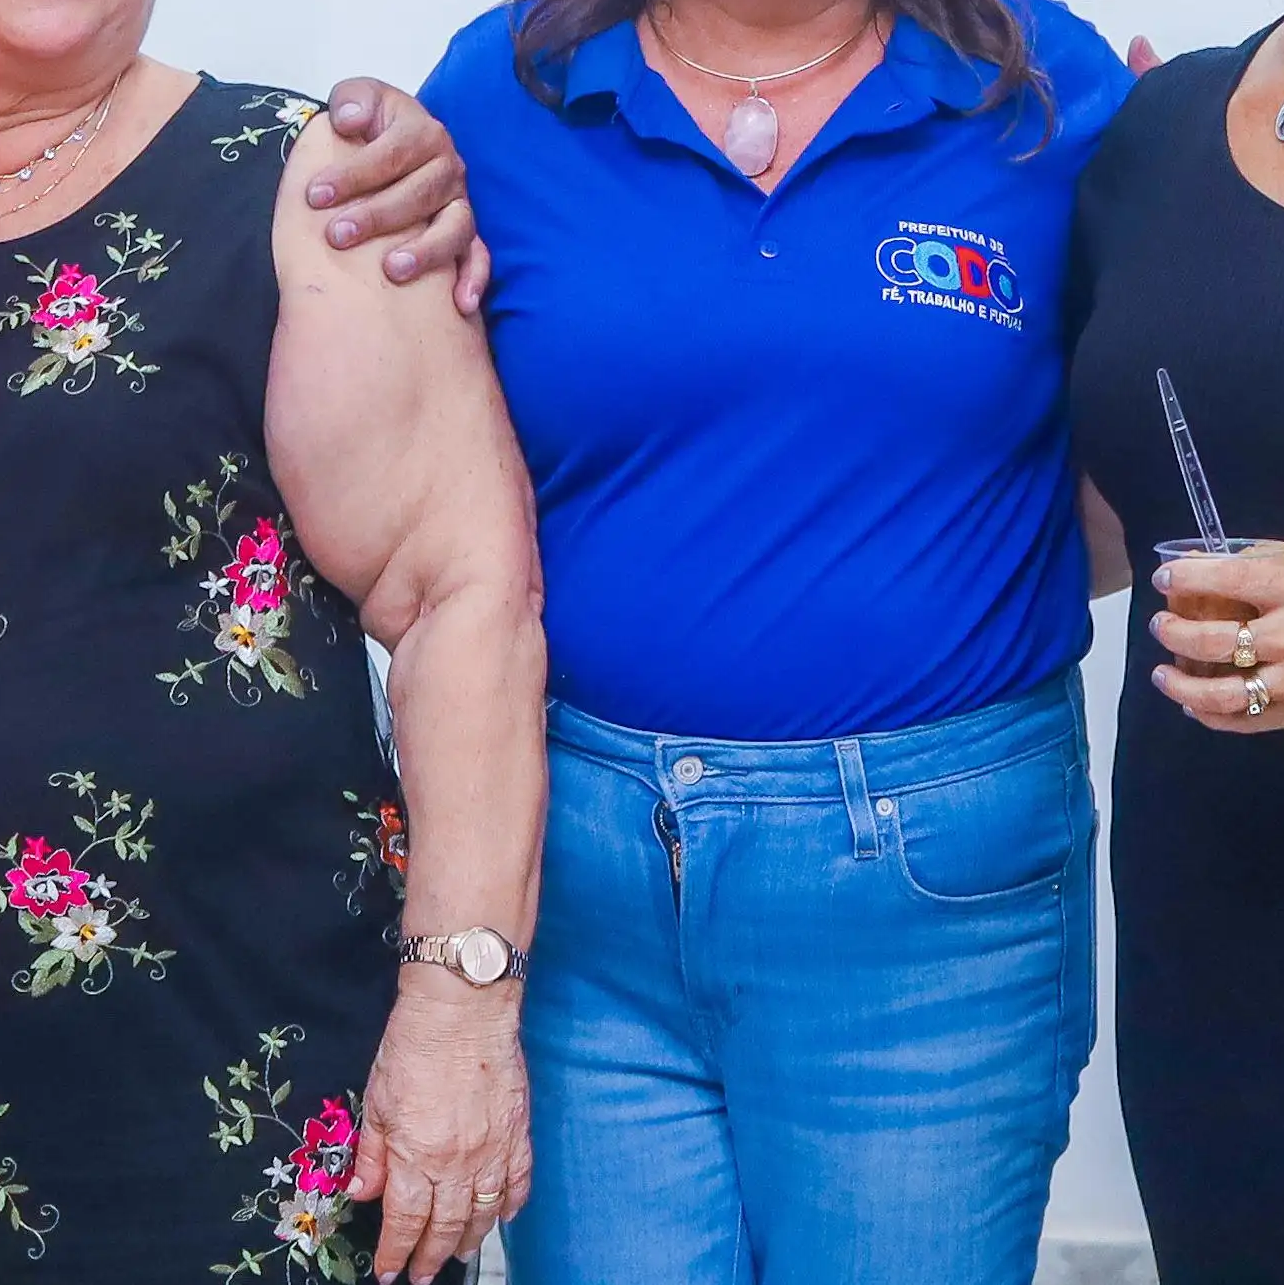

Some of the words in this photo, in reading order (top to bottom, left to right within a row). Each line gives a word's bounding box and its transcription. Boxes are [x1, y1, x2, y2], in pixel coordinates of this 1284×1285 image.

[898, 220, 986, 247] PREFEITURA
[881, 285, 905, 305] FÉ,
[906, 289, 976, 316] TRABALHO
[978, 303, 988, 320] E
